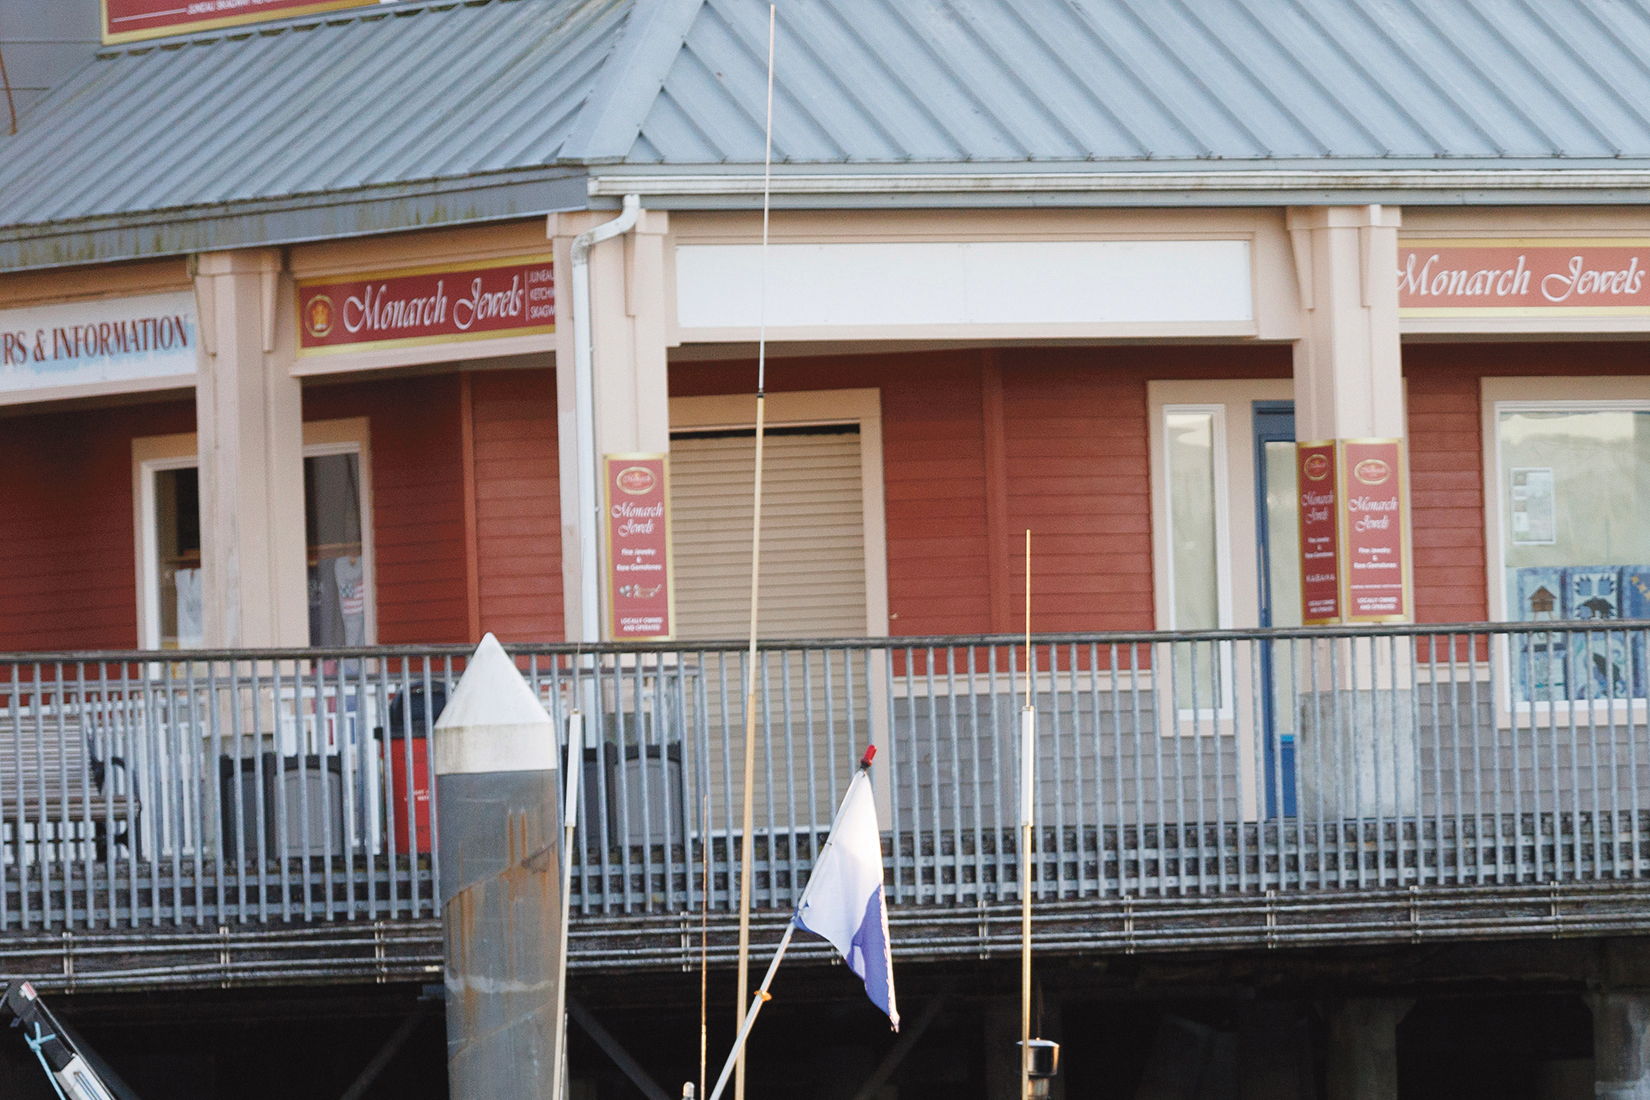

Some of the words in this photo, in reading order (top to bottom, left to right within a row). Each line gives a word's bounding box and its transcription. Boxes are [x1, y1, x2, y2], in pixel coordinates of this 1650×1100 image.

[1397, 253, 1532, 297] Monarch
[1541, 255, 1646, 302] Jewels
[343, 279, 448, 333] Monarch
[453, 274, 525, 330] Jewels
[0, 330, 28, 366] RS
[33, 328, 46, 362] &
[53, 314, 190, 360] INFORMATION
[611, 501, 663, 519] Monarch
[1348, 496, 1398, 512] Monarch
[618, 518, 655, 538] Jewels
[1355, 515, 1389, 532] Jewels
